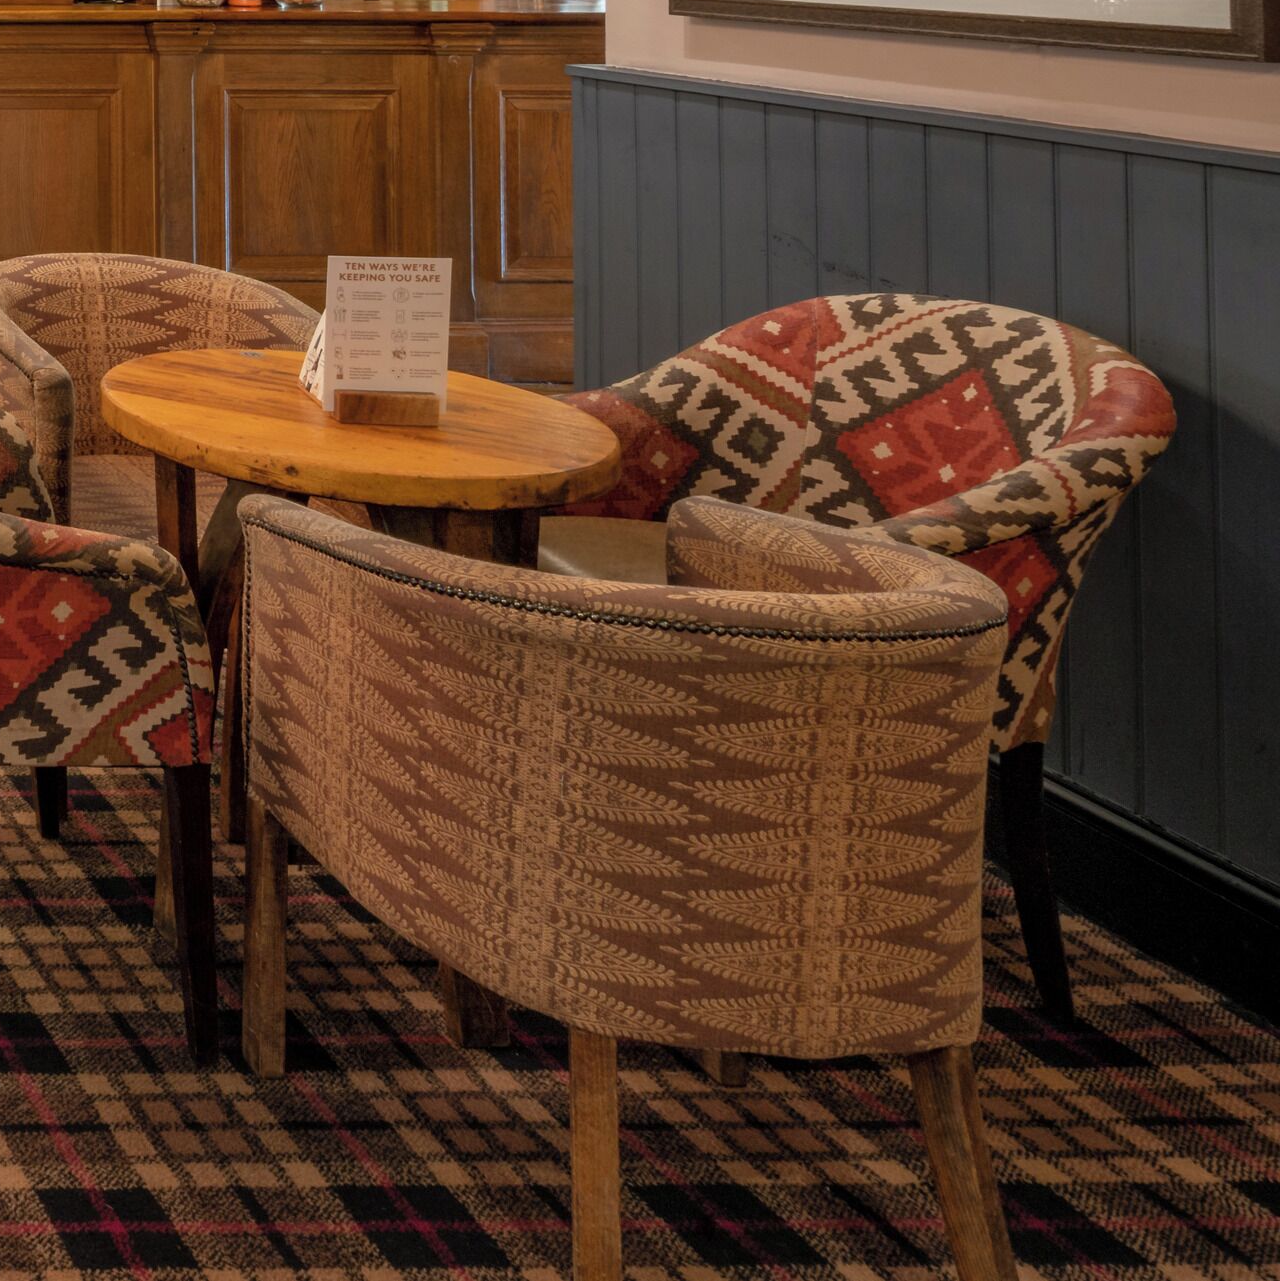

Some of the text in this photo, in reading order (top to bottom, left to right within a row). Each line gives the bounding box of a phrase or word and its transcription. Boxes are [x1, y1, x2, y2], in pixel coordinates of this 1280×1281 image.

[345, 262, 436, 272] TEN WAYS WE'RE
[339, 272, 441, 283] KEEPING YOU SAFE
